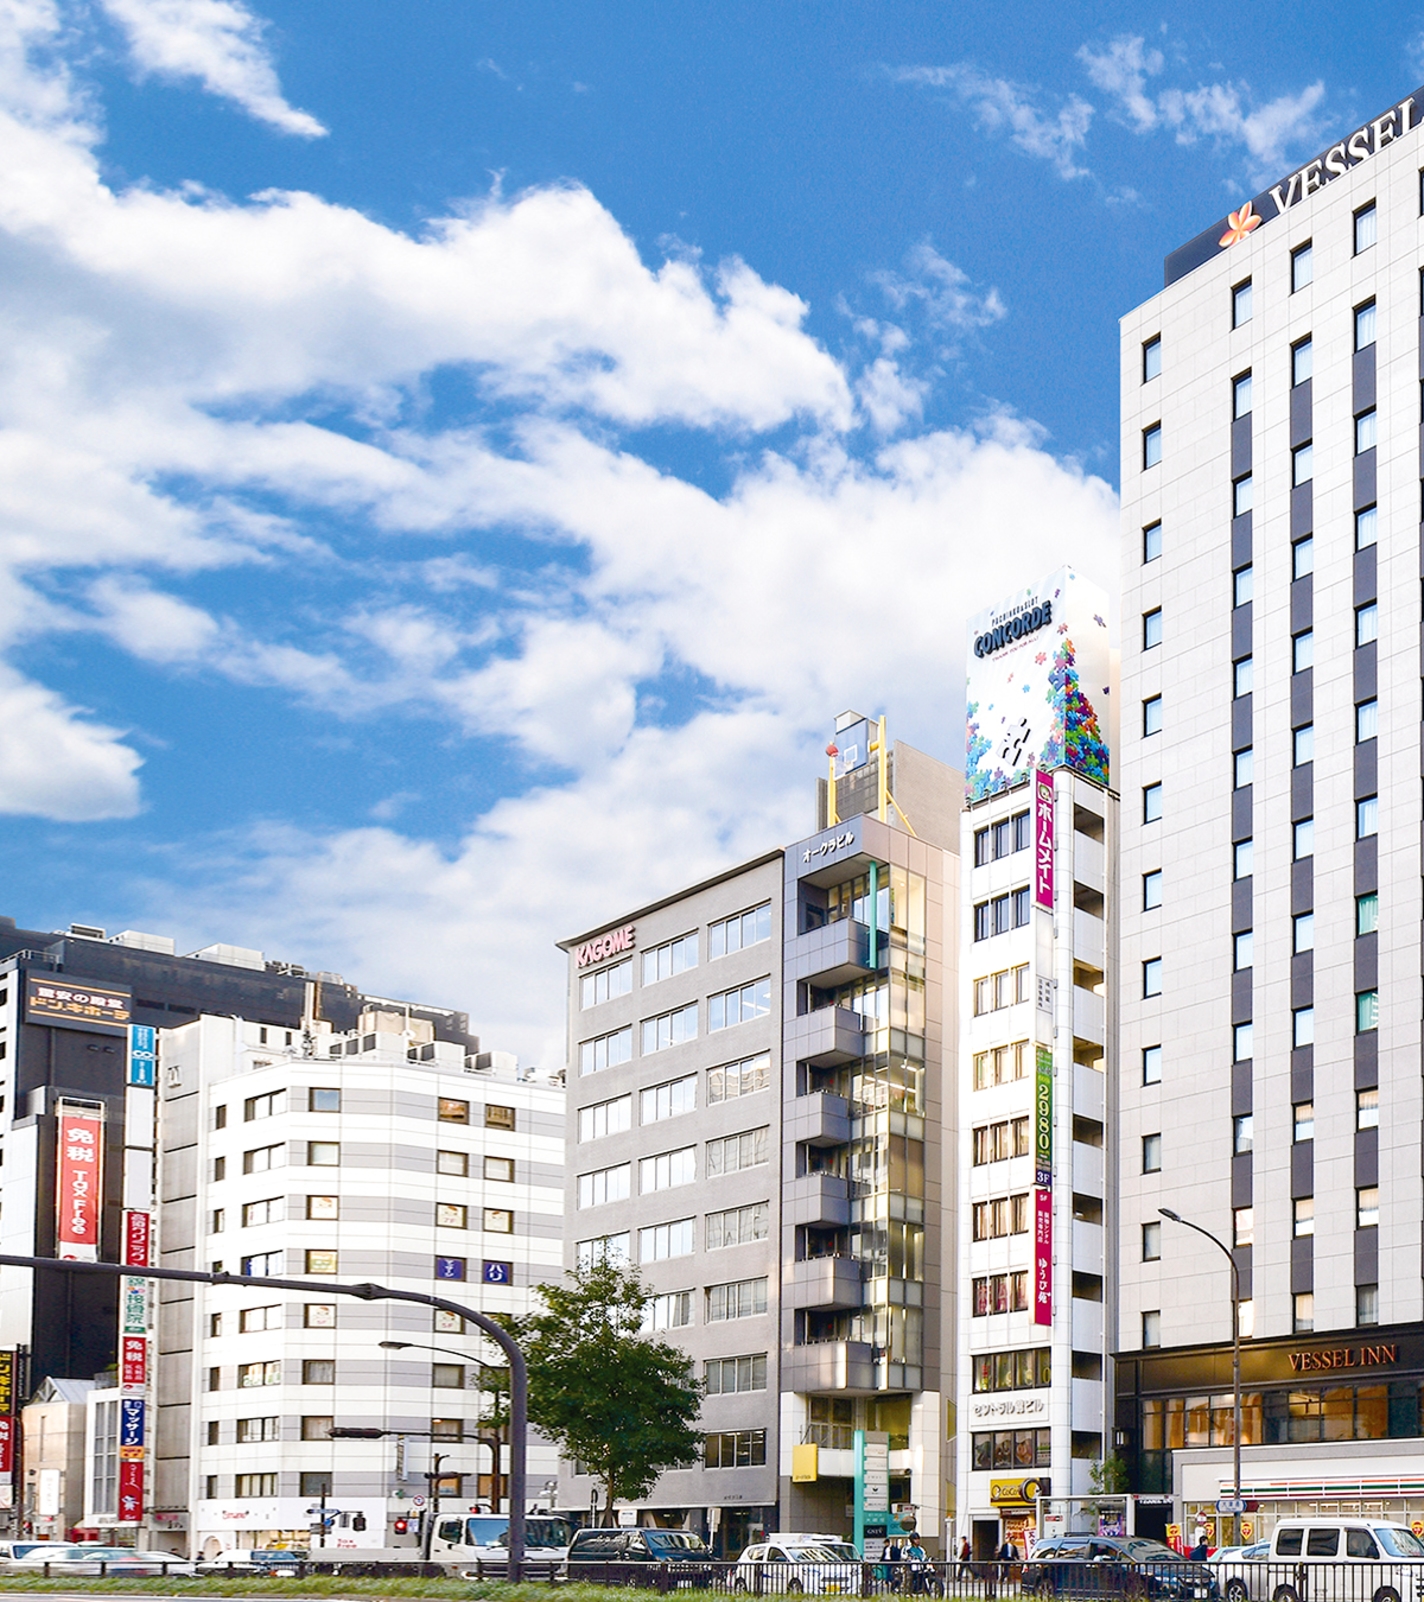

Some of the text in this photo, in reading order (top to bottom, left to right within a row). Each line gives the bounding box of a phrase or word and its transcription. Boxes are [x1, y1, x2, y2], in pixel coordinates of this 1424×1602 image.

[974, 600, 1053, 658] CONCORDE
[802, 831, 855, 863] オークラビル
[1038, 803, 1053, 894] ホームメイト
[575, 925, 636, 969] KAGOME
[1038, 1084, 1050, 1150] 2980
[66, 1127, 95, 1162] 免税
[71, 1199, 88, 1235] Free
[131, 1213, 146, 1266] 高須クリニッ
[488, 1264, 504, 1281] ハリ
[126, 1340, 143, 1361] 免税
[1288, 1344, 1396, 1371] VESSEL INN
